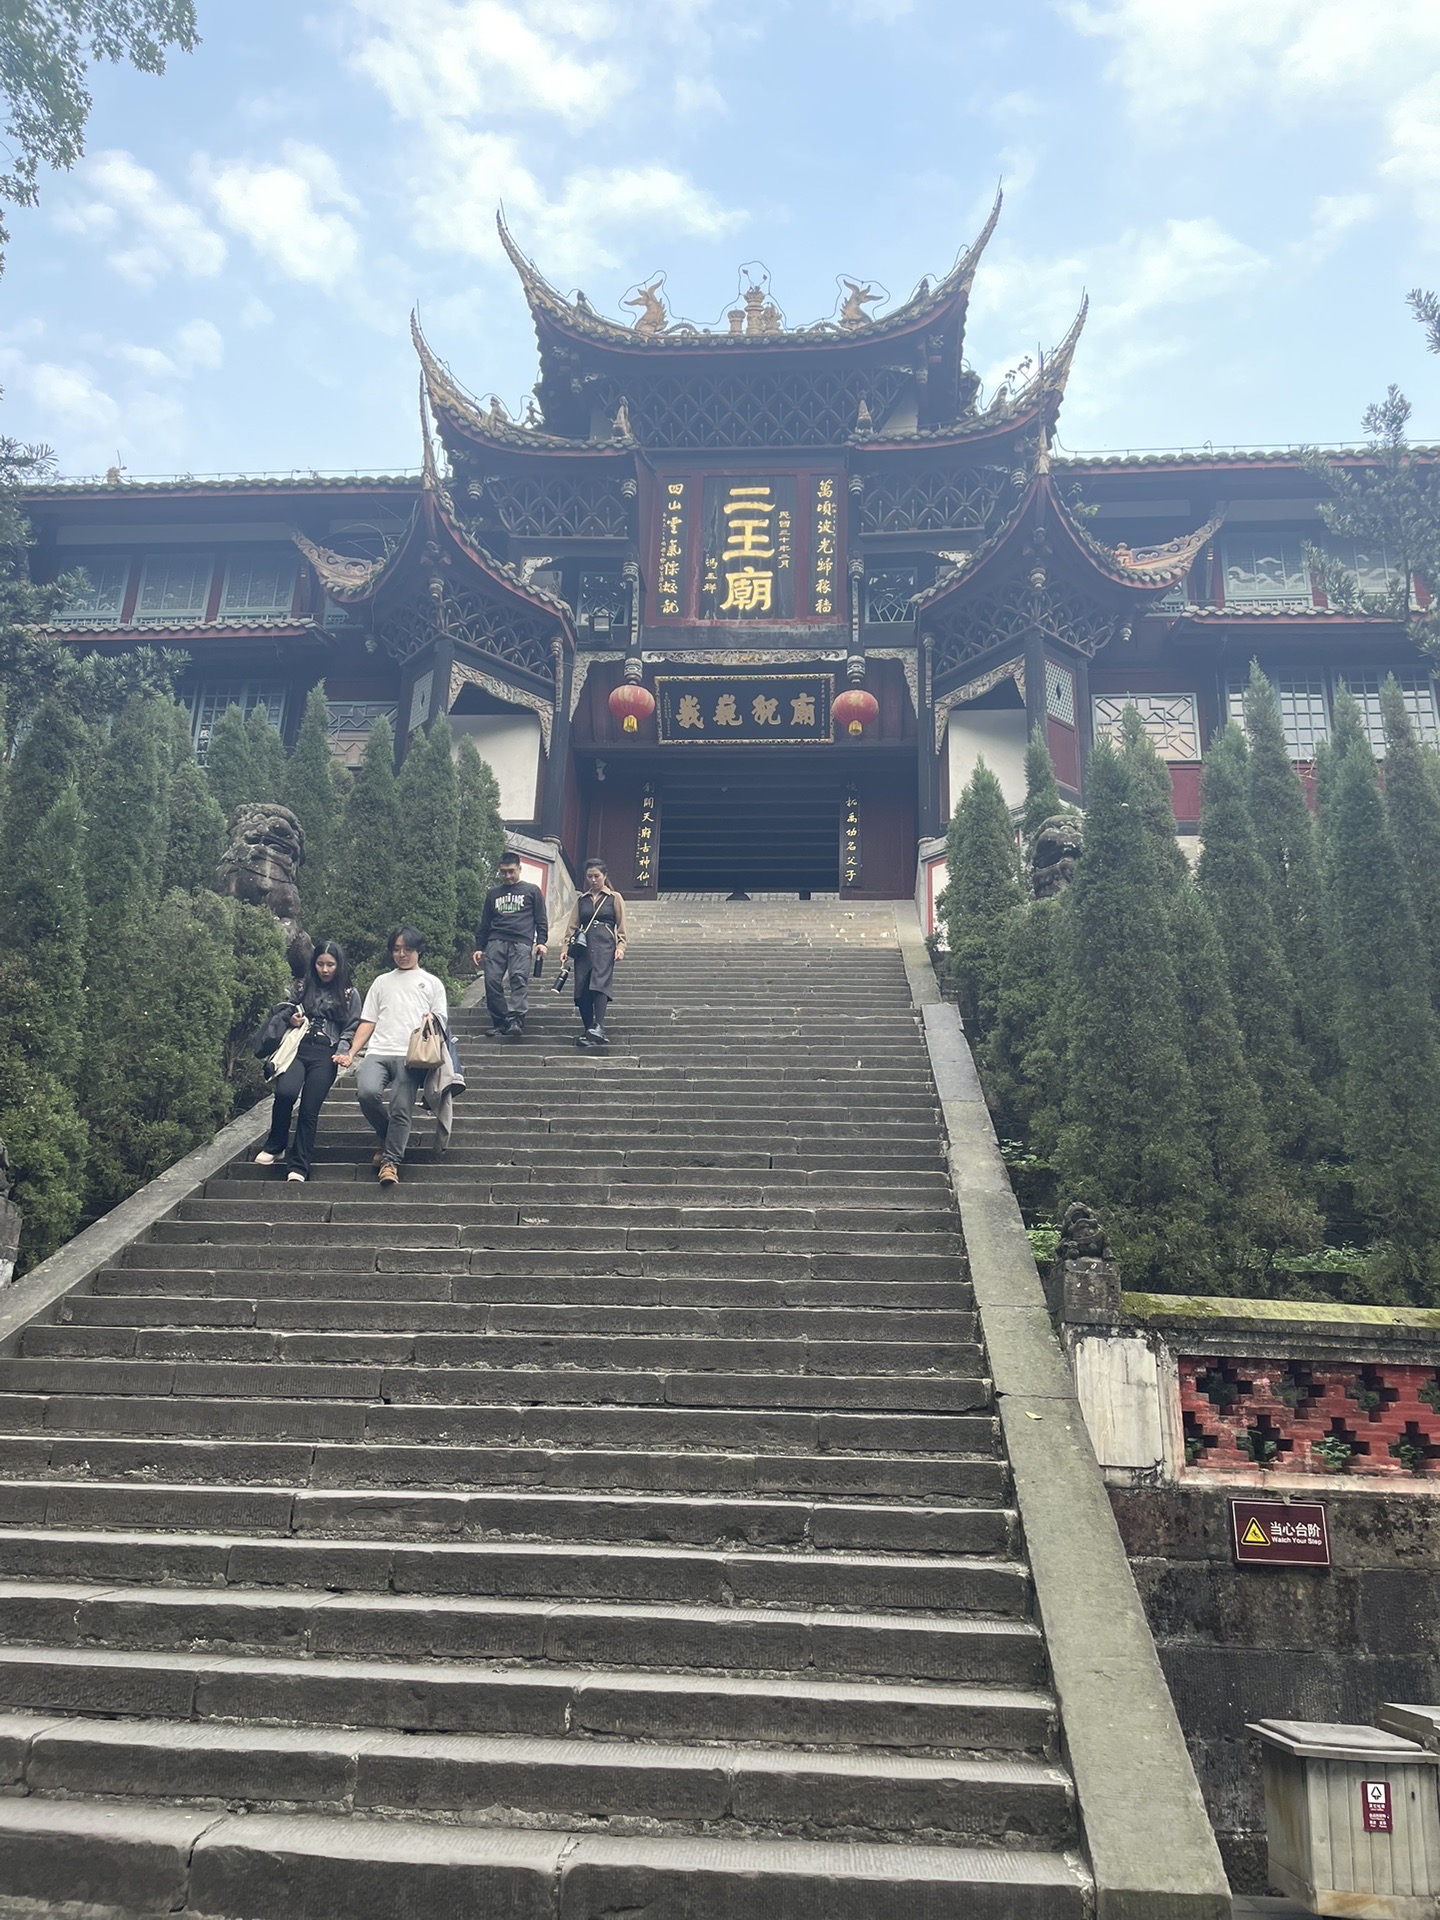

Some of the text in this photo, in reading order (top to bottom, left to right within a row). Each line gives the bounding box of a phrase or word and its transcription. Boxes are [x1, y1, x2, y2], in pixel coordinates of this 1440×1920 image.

[719, 486, 776, 611] 二王廟
[1270, 1521, 1321, 1537] 当心台阶
[1271, 1536, 1292, 1544] Watch
[1307, 1538, 1322, 1546] Step
